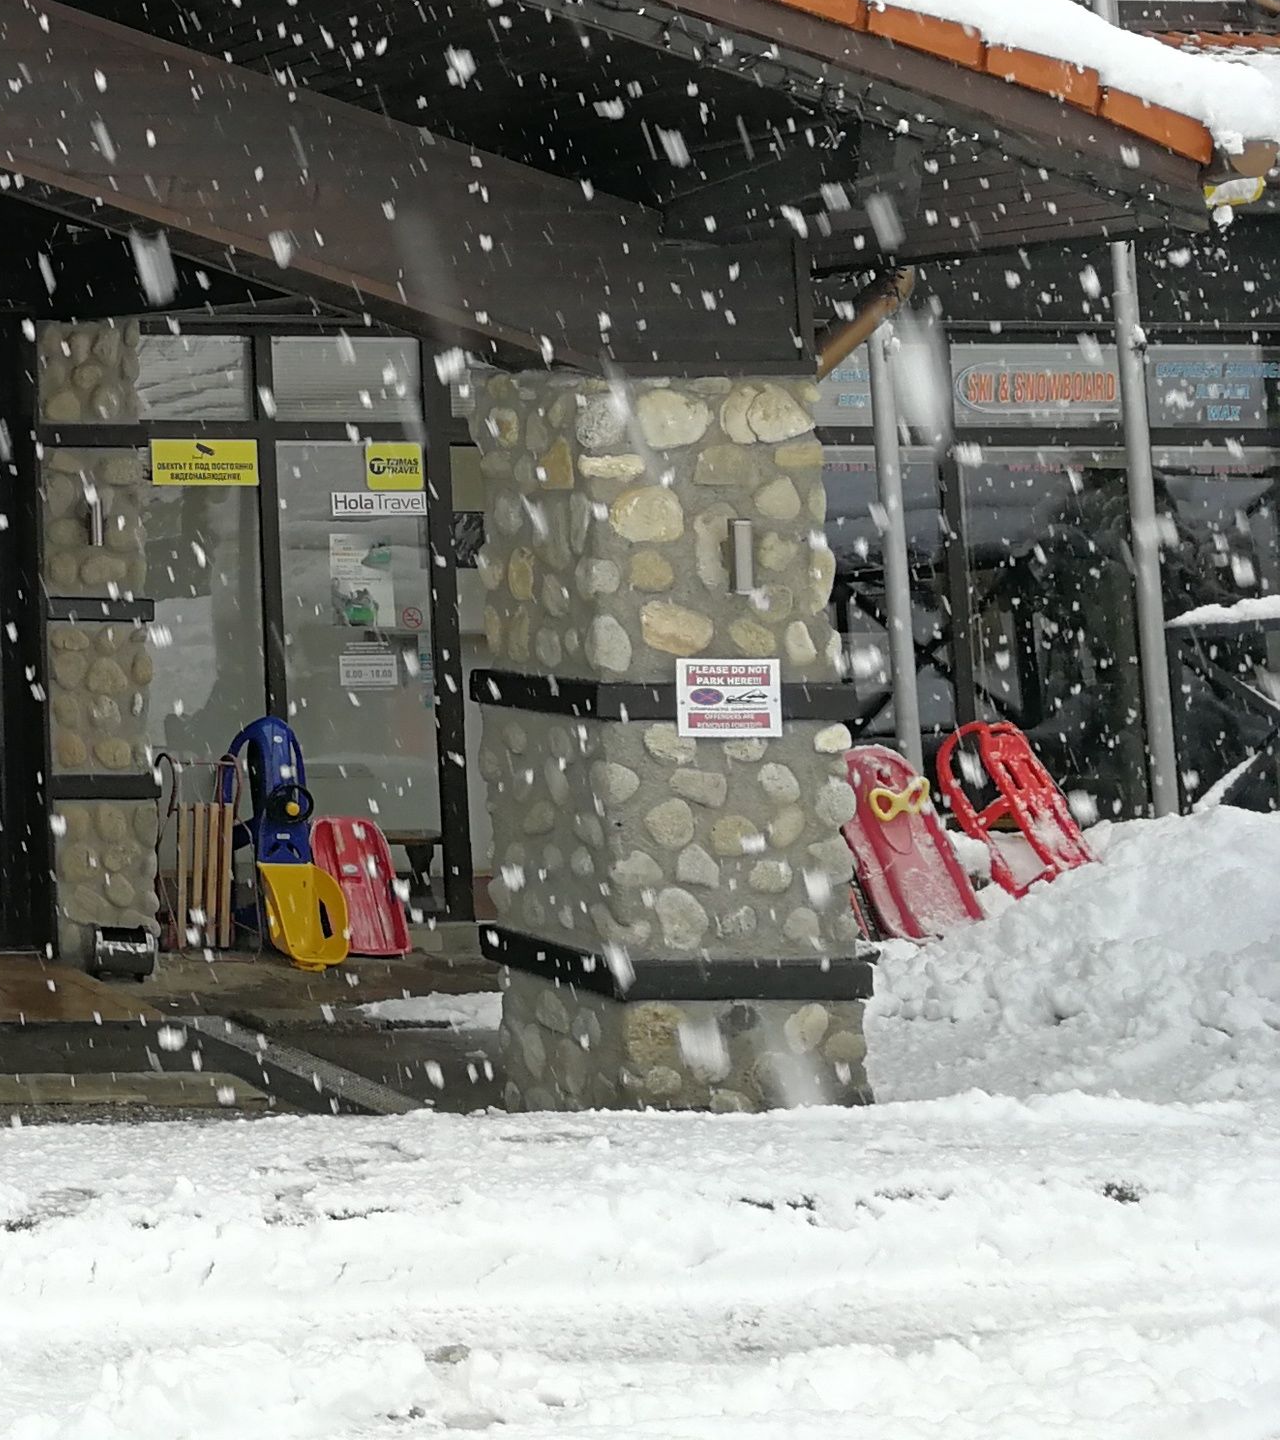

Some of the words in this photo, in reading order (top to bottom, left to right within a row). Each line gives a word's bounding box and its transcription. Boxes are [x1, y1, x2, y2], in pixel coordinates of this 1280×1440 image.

[968, 372, 994, 403] SKI
[998, 372, 1010, 403] &
[1015, 371, 1116, 403] SNOWBOARD
[689, 665, 729, 674] PLEASE
[731, 665, 745, 674] DO
[747, 665, 768, 674] NOT
[696, 676, 725, 685] PARK
